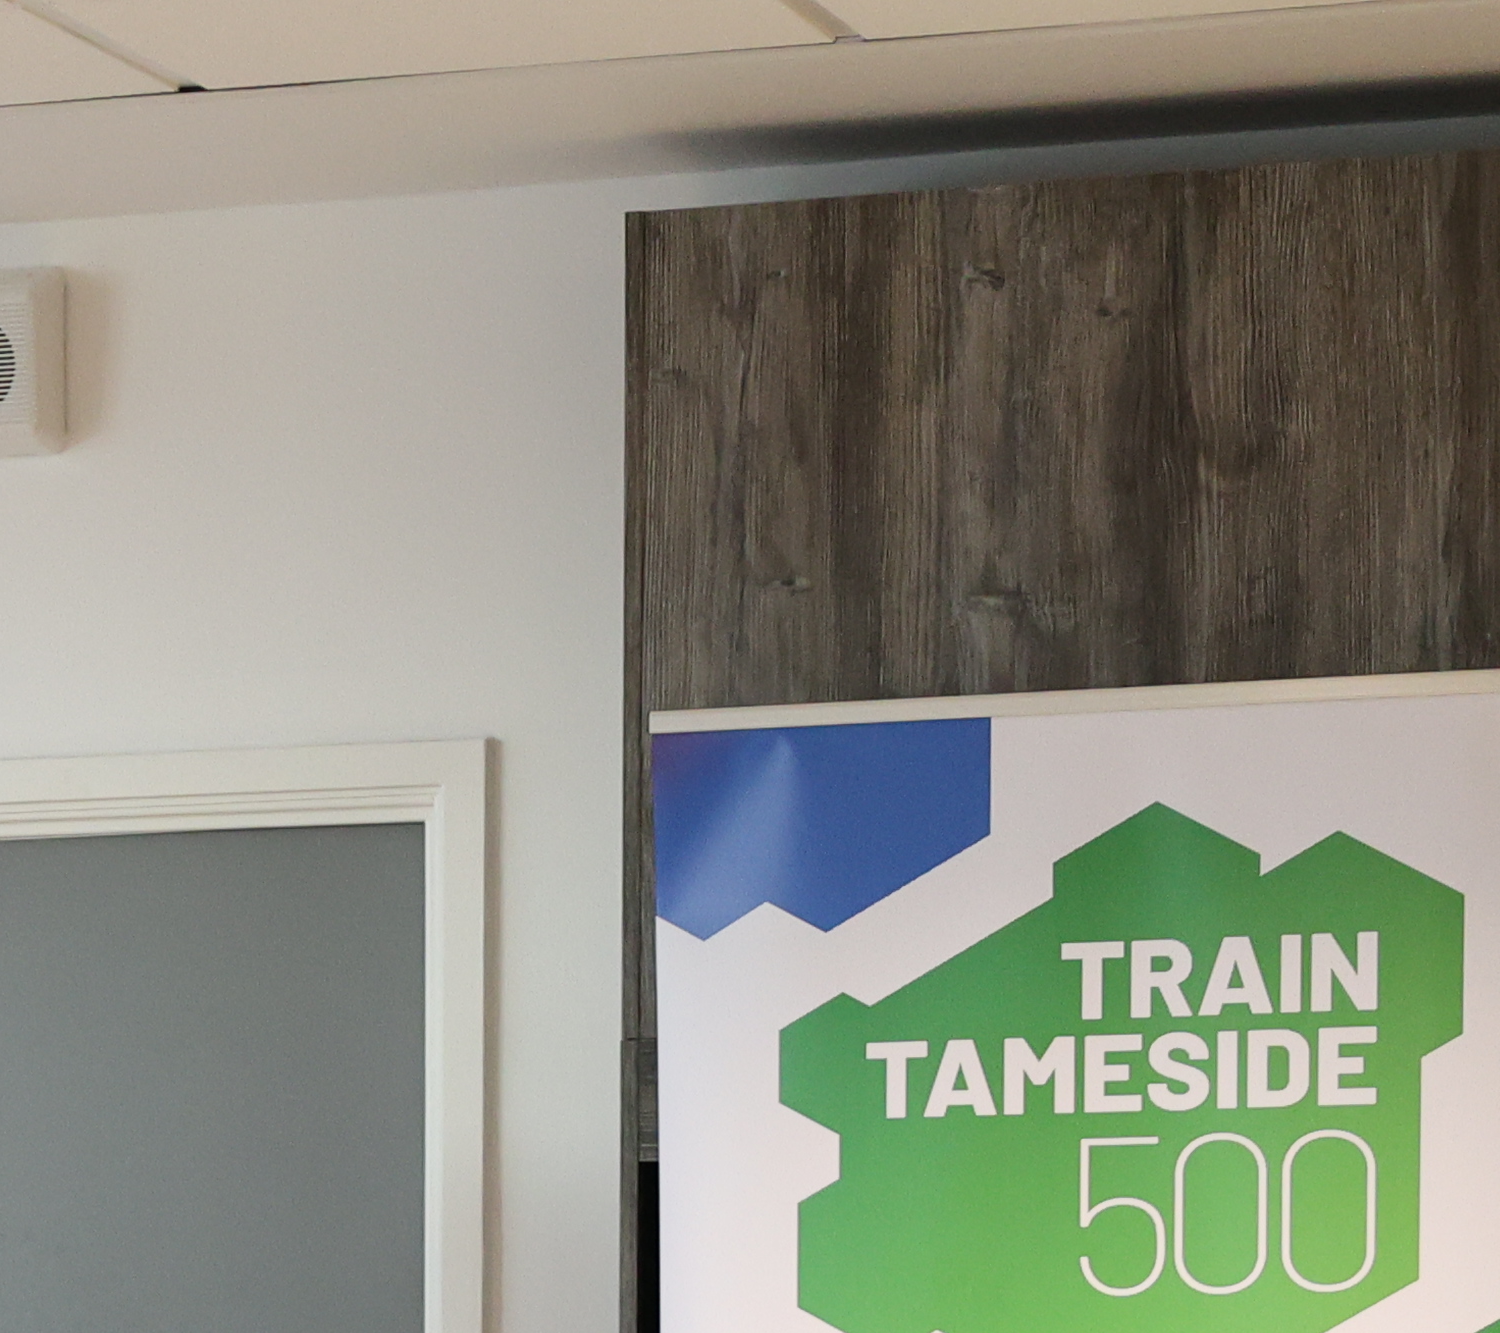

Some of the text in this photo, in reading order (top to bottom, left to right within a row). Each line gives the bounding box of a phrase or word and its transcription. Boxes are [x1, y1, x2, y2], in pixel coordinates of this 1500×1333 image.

[1062, 932, 1377, 1019] TRAIN
[867, 1027, 1377, 1118] TAMESIDE
[1080, 1130, 1376, 1296] 500
